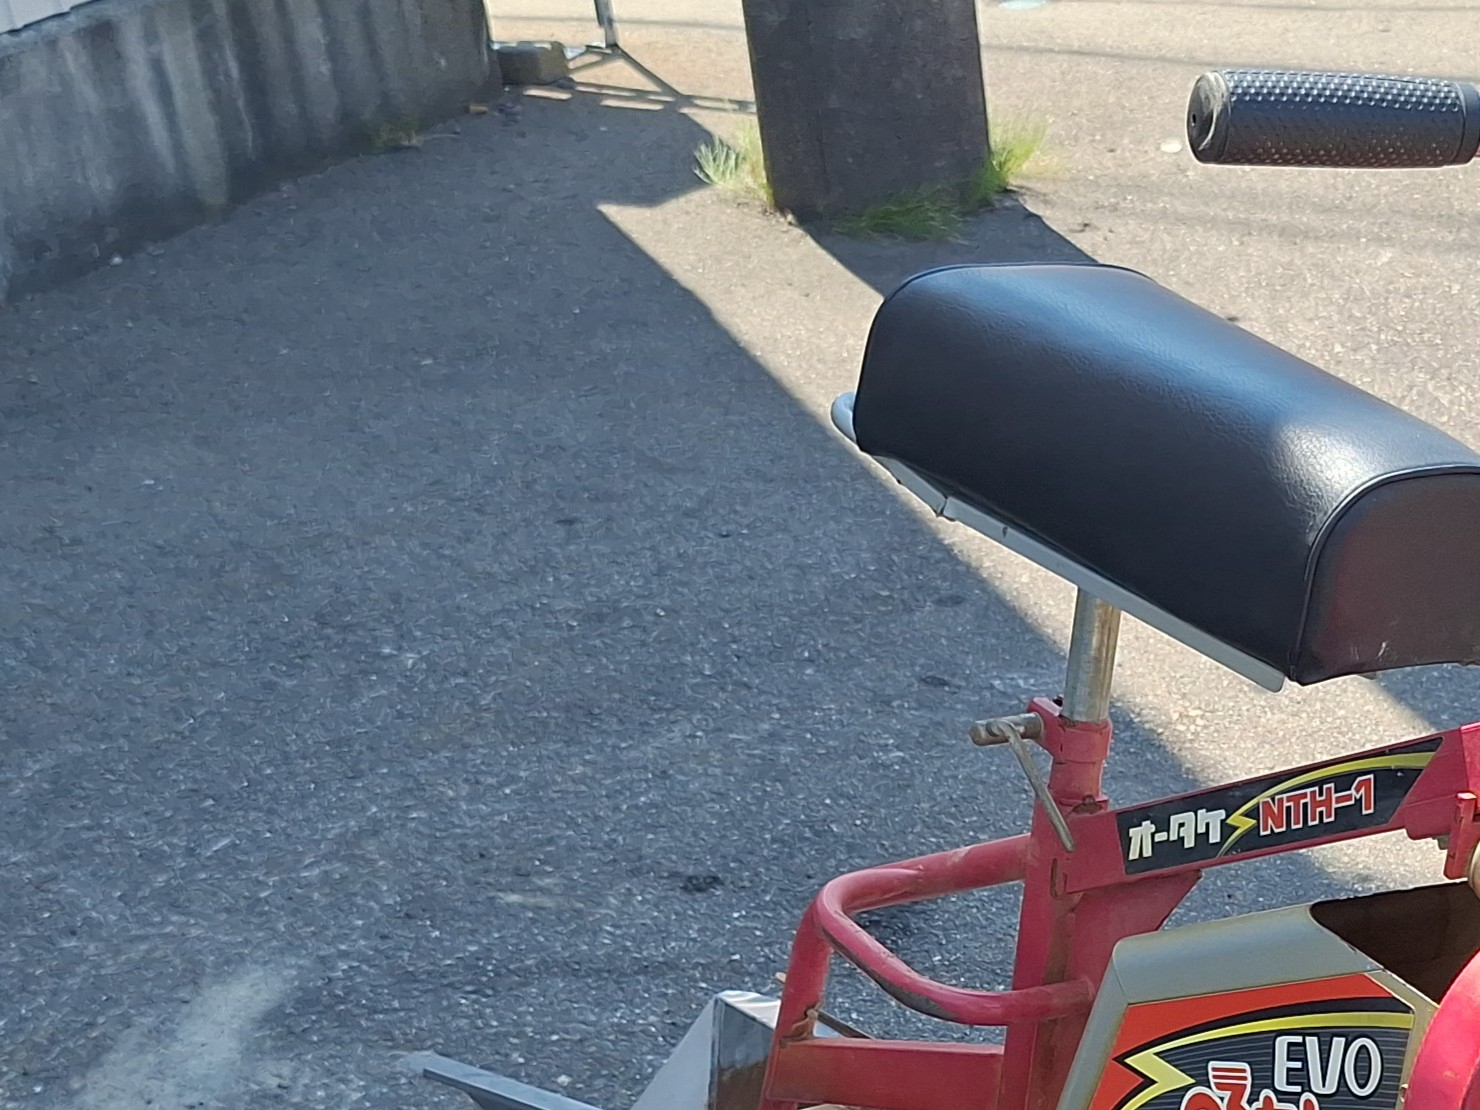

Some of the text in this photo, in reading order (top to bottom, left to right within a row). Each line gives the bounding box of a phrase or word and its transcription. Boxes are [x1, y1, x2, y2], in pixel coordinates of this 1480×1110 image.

[1128, 808, 1226, 860] オータケ
[1259, 774, 1375, 836] NTH-1
[1273, 1035, 1383, 1097] EVO
